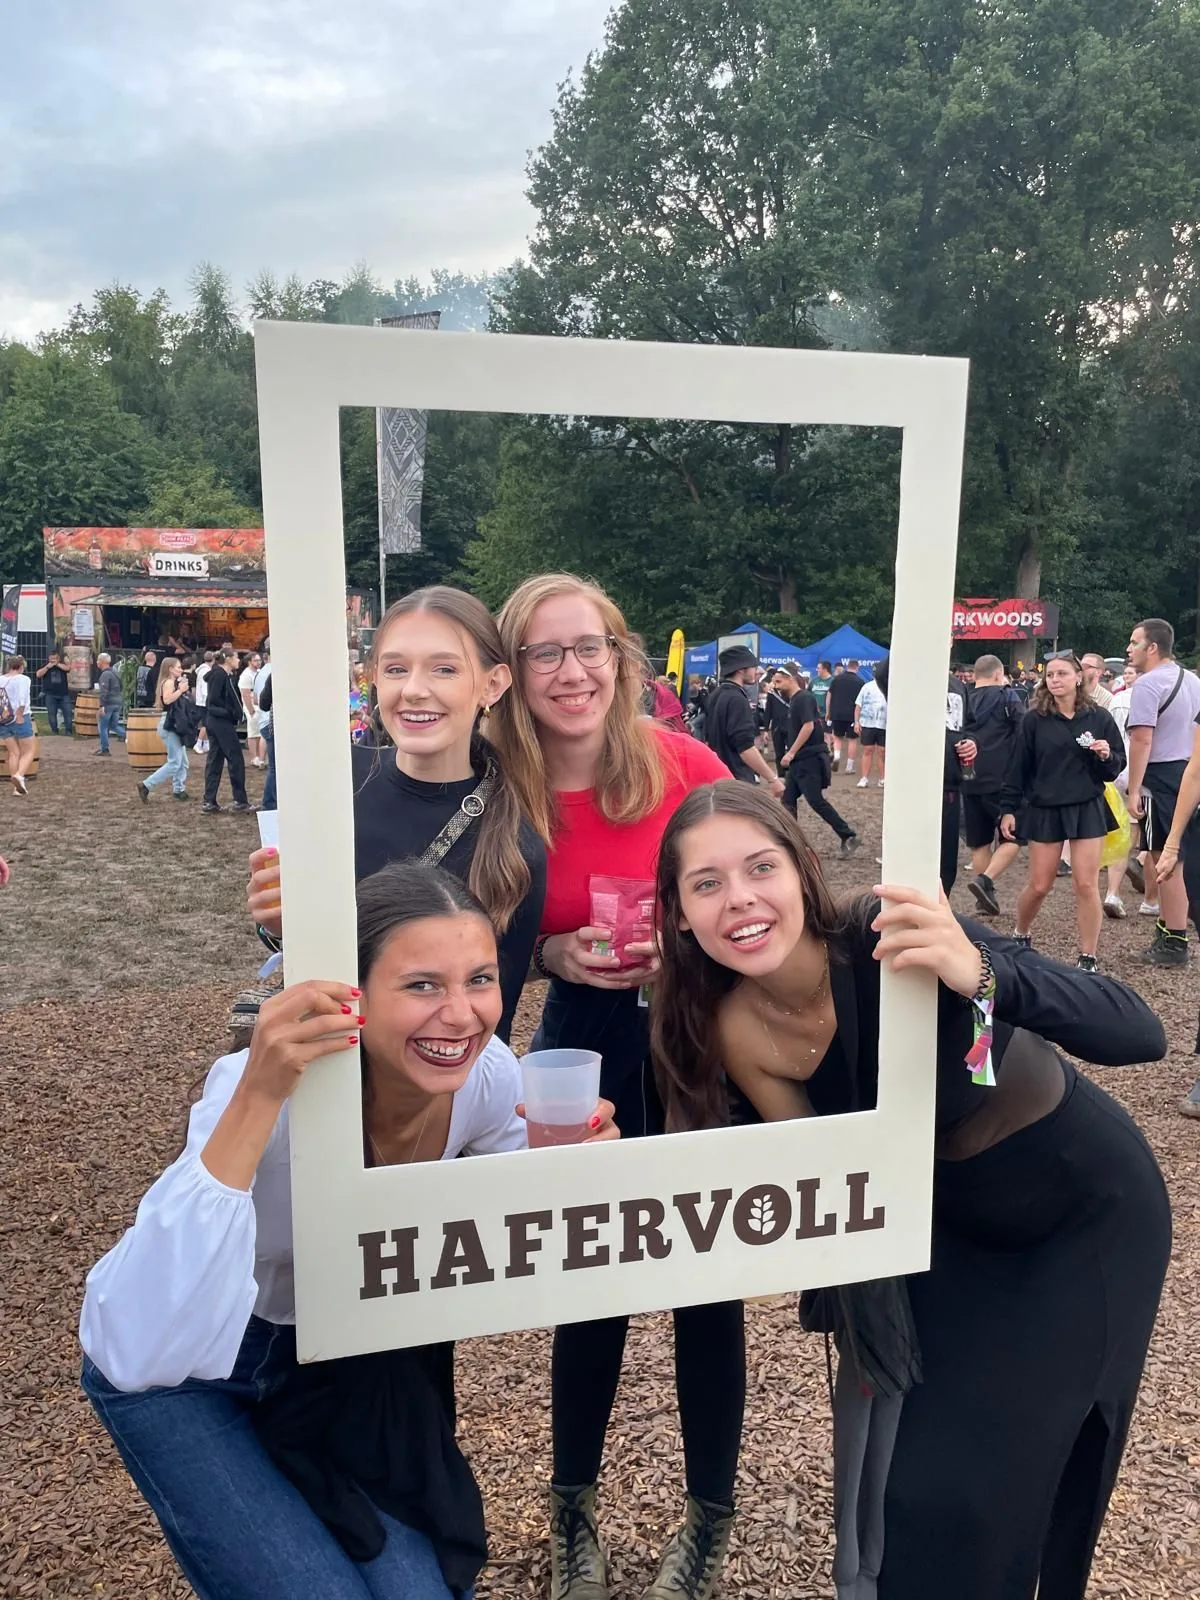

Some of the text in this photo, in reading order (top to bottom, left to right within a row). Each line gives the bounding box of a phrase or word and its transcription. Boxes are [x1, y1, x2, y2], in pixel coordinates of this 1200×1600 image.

[155, 559, 203, 572] DRINKS
[952, 611, 1043, 627] RKWOODS
[358, 1171, 886, 1300] HAFERVOLL
